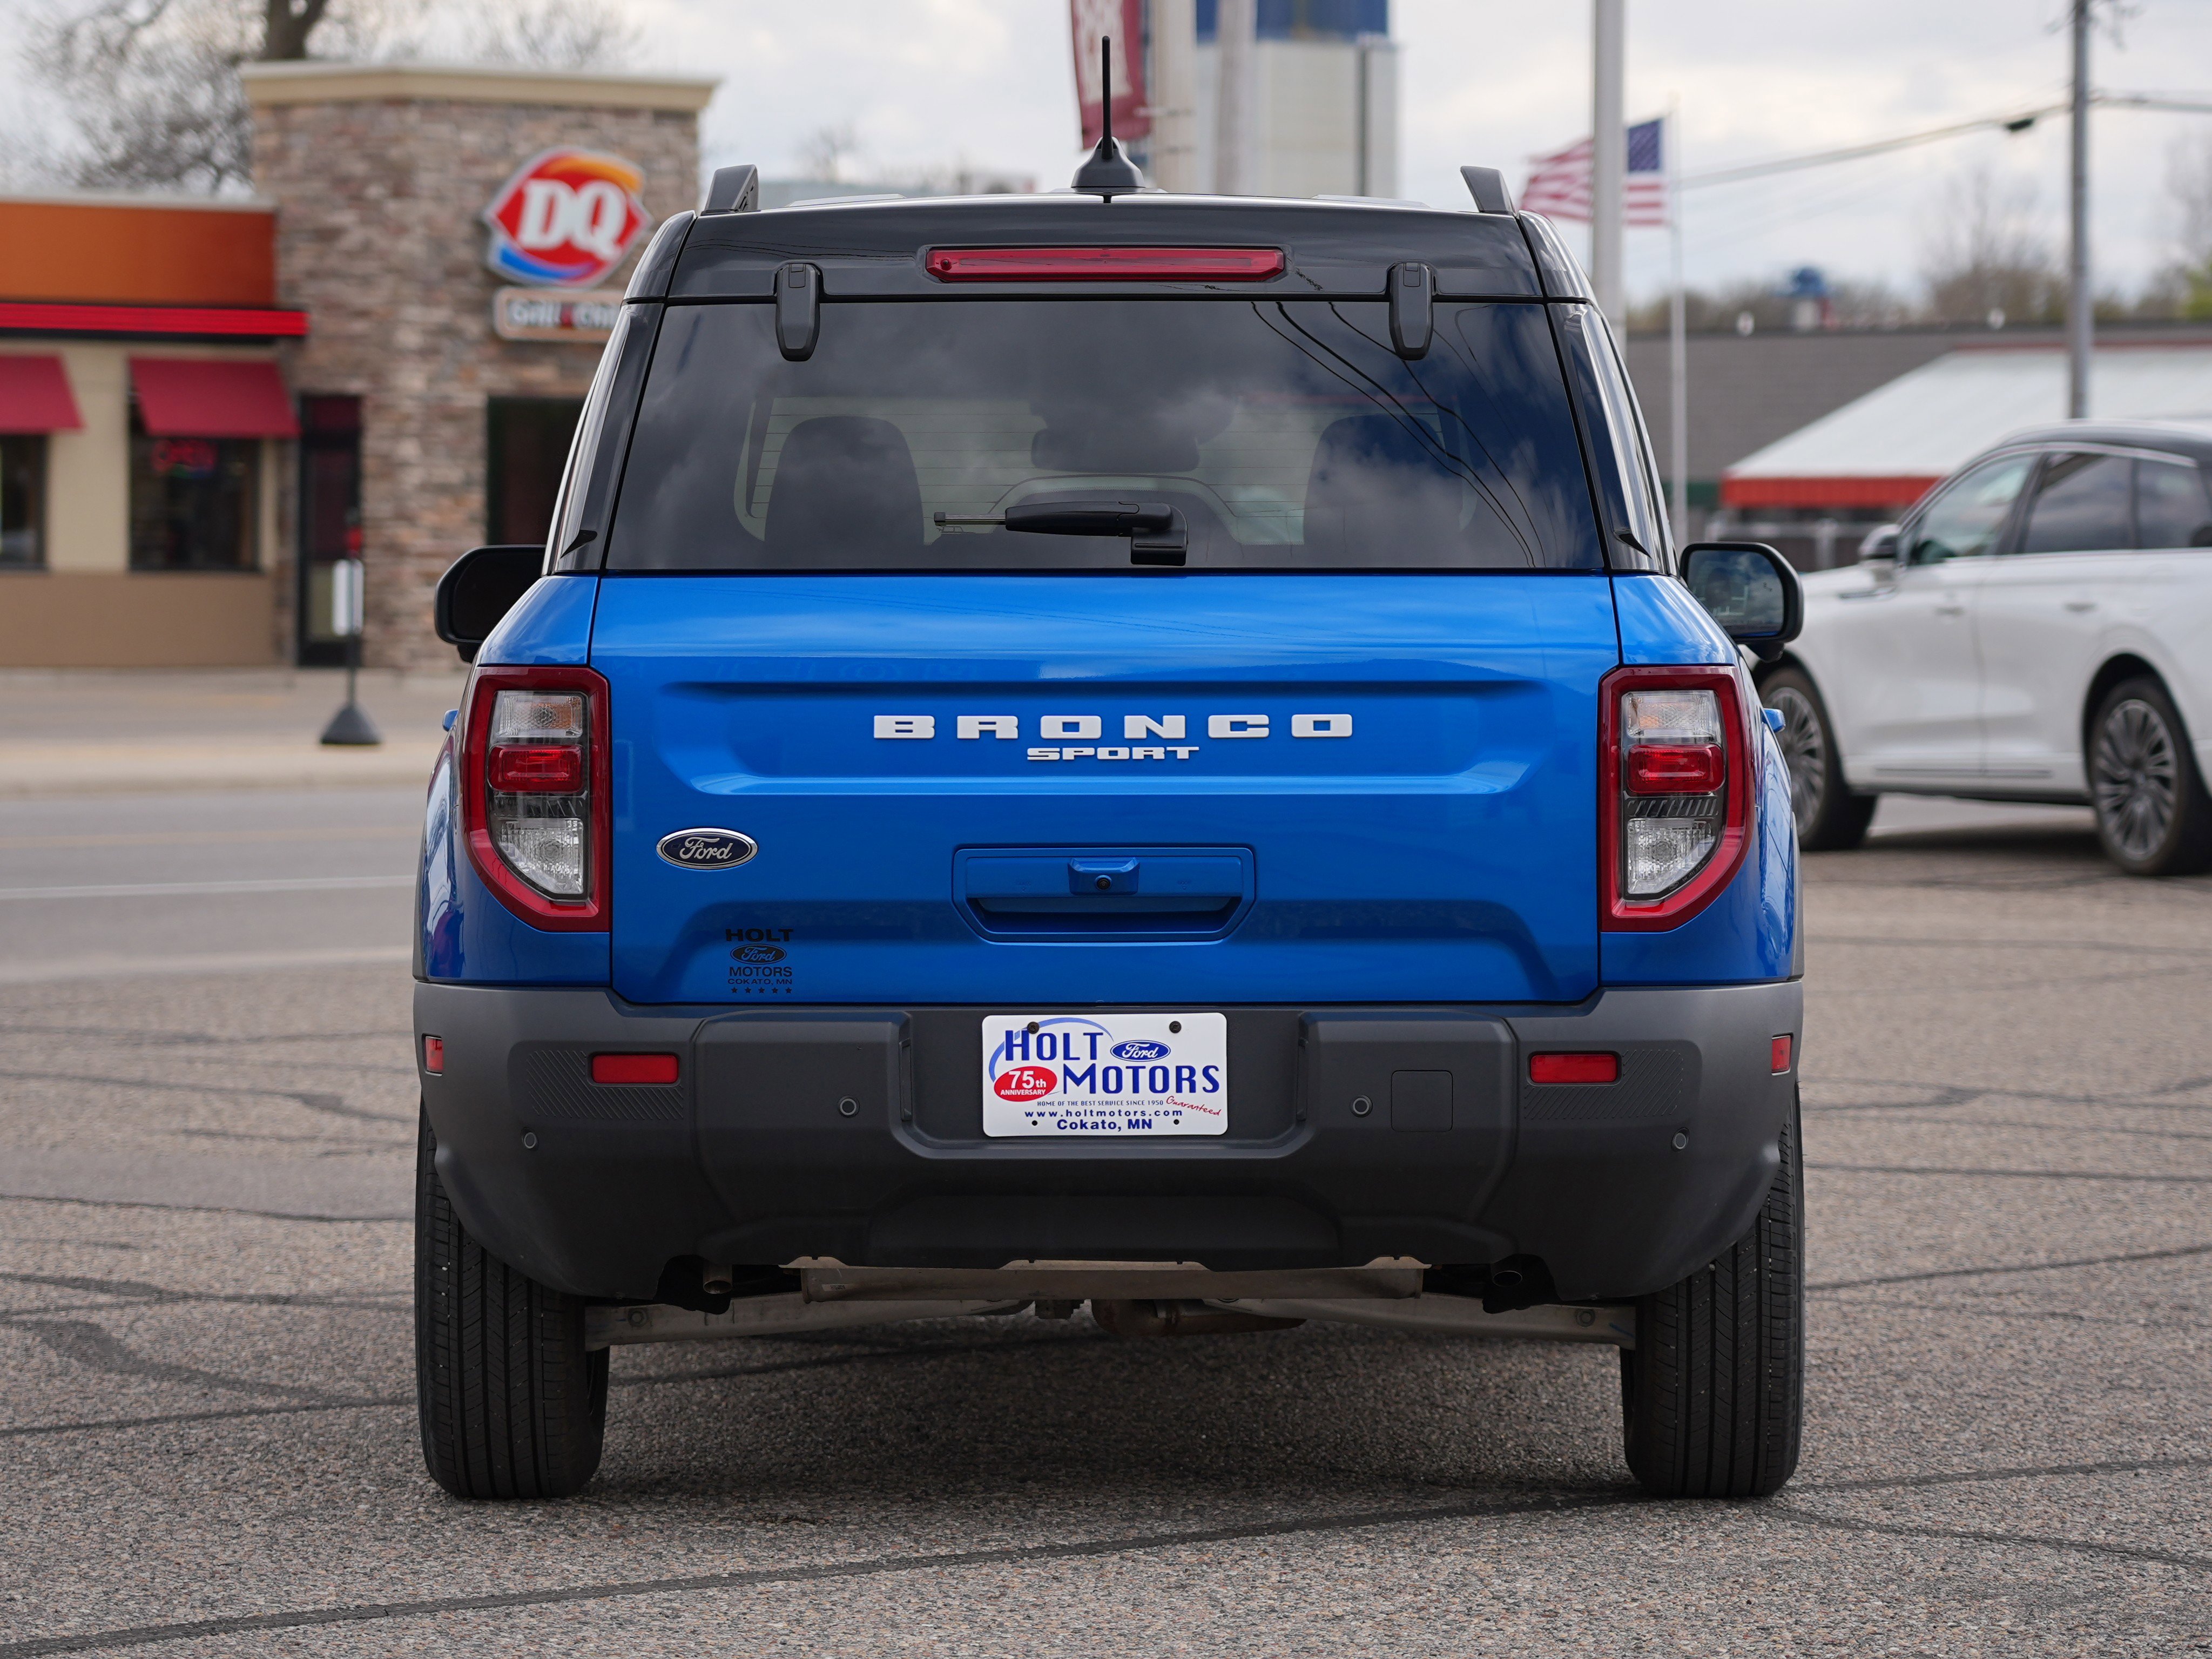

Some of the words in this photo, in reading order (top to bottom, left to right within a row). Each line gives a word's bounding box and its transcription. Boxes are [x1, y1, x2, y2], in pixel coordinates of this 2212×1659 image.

[519, 179, 623, 262] DQ
[874, 714, 1353, 739] BRONCO
[1027, 746, 1199, 760] SPORT
[679, 837, 733, 860] Ford
[726, 928, 793, 942] HOLT
[741, 946, 776, 961] Ford
[729, 966, 792, 977] MOTORS
[1005, 1030, 1103, 1061] HOLT
[1122, 1042, 1159, 1058] Ford
[1008, 1070, 1047, 1089] 75th
[1063, 1063, 1219, 1094] MOTORS
[1166, 1095, 1222, 1116] Guaranteed
[1057, 1119, 1122, 1131] Cokato,
[1128, 1119, 1152, 1129] MN
